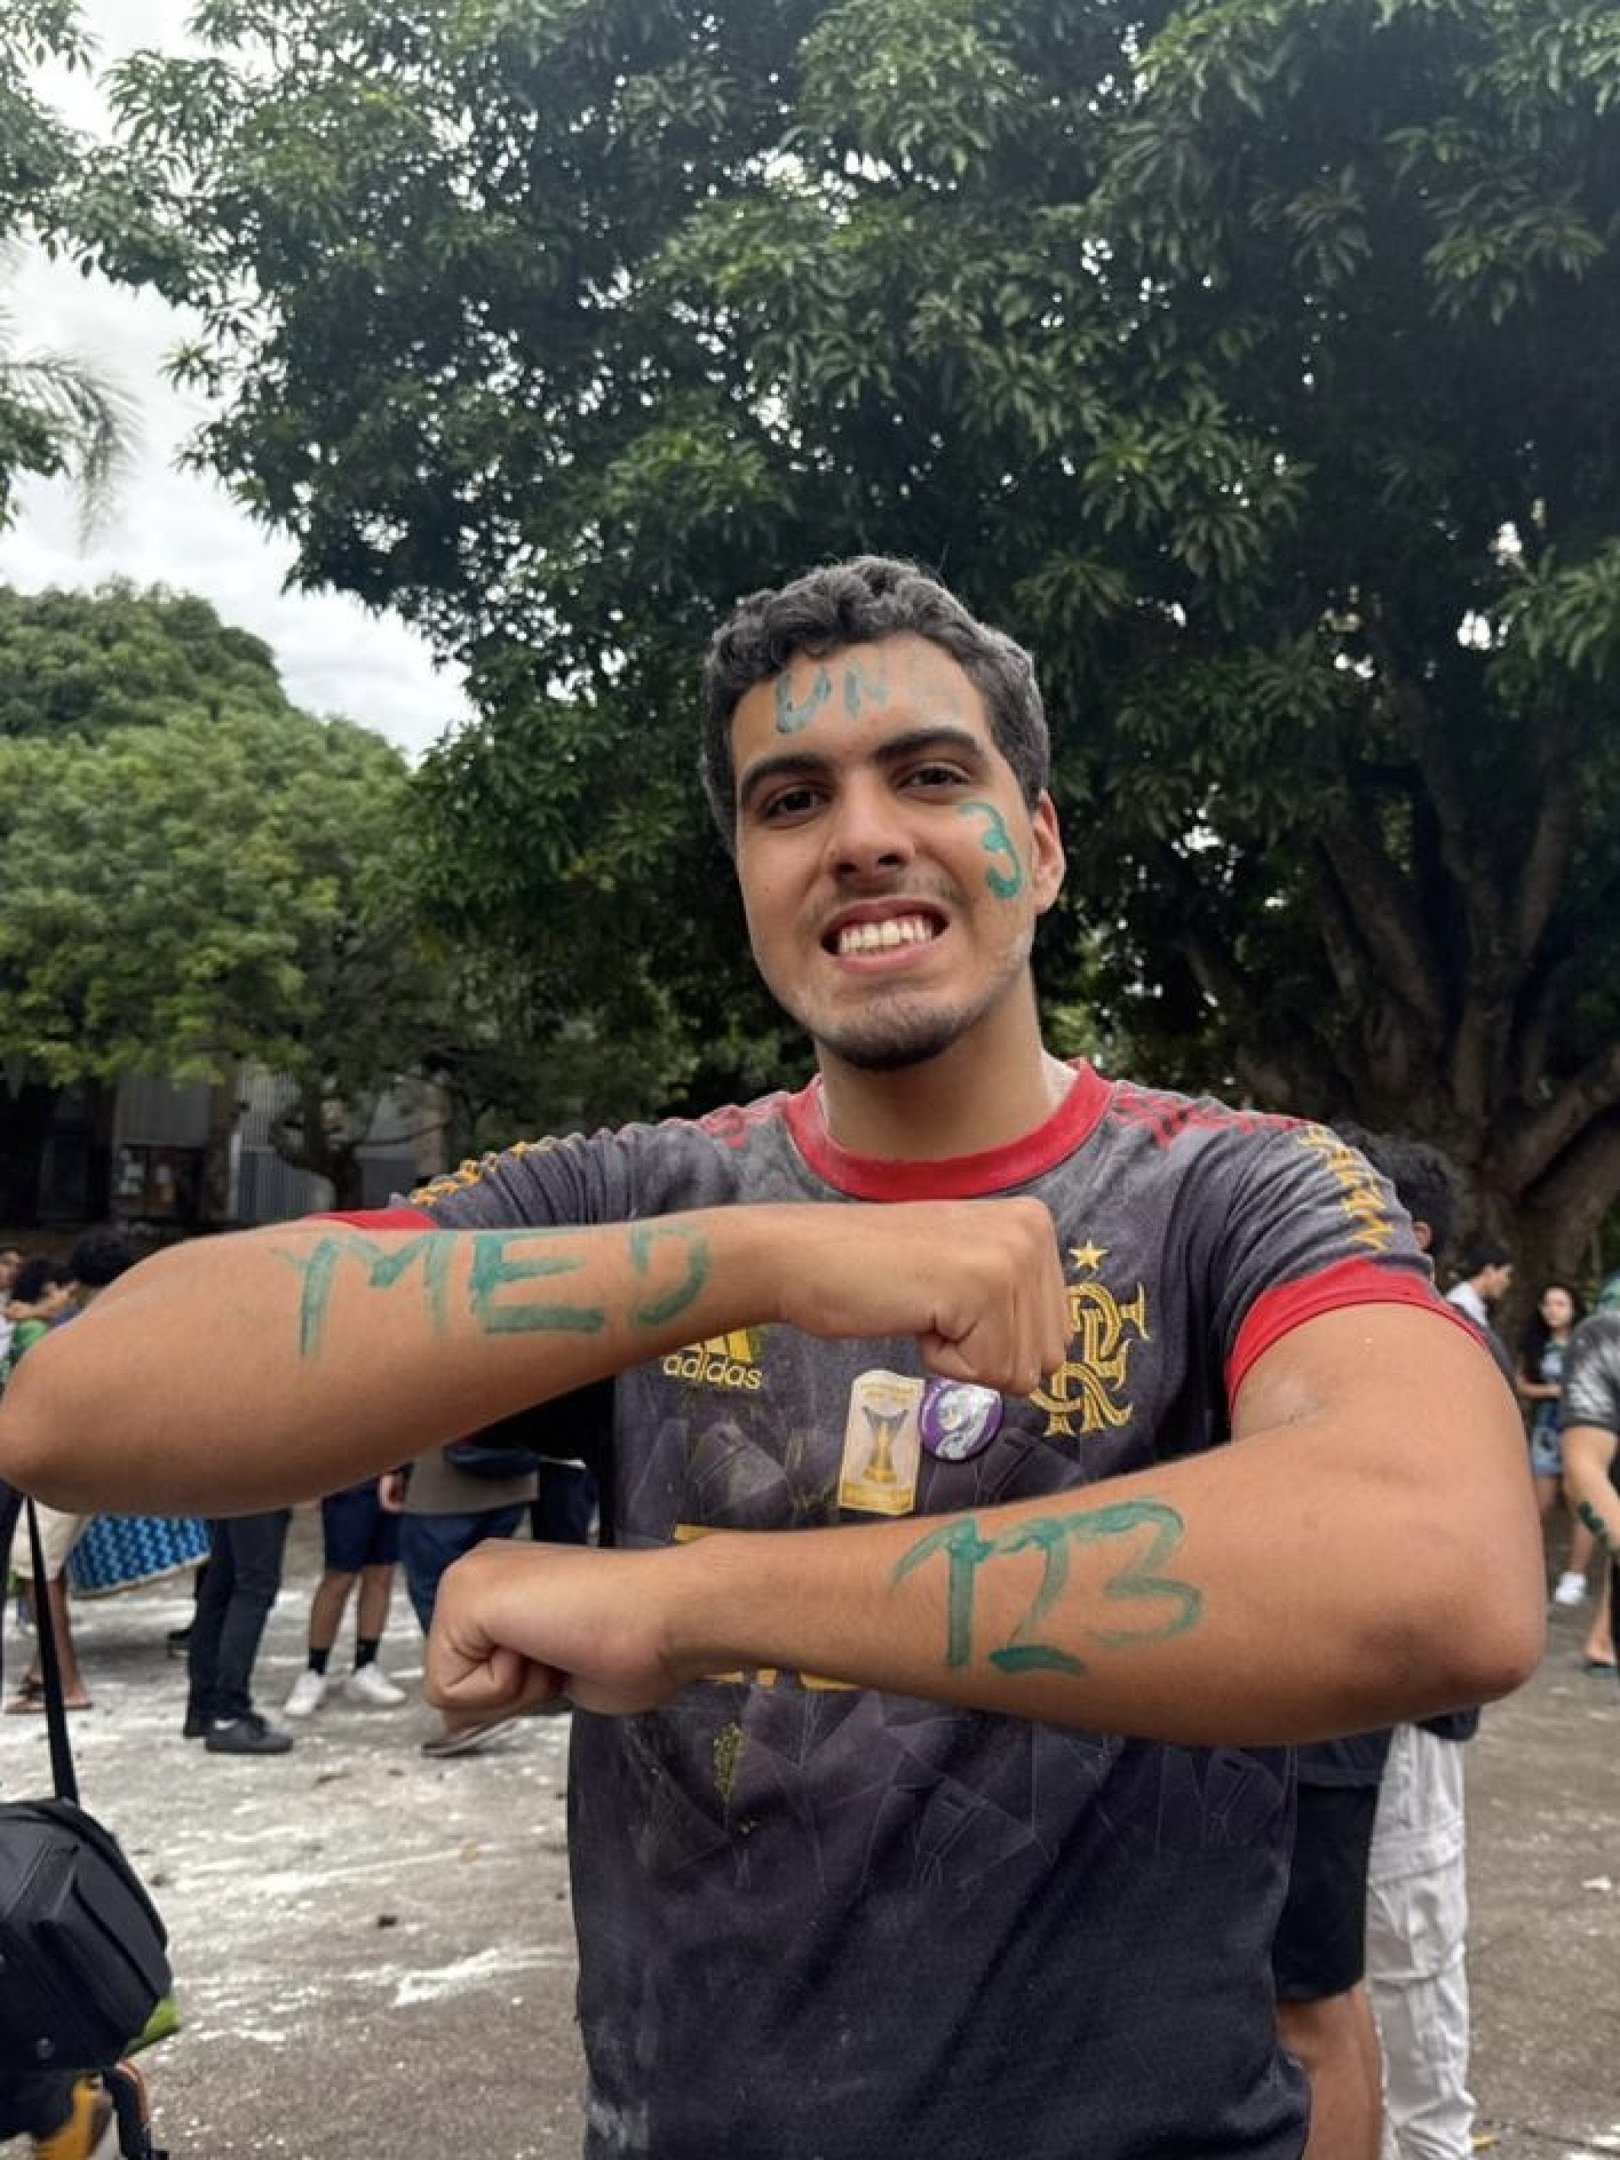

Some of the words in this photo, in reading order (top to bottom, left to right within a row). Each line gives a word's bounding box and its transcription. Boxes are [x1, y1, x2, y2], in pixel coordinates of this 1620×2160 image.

[270, 1228, 711, 1360] MED
[662, 1346, 764, 1391] adidas
[890, 1499, 1204, 1675] 123
